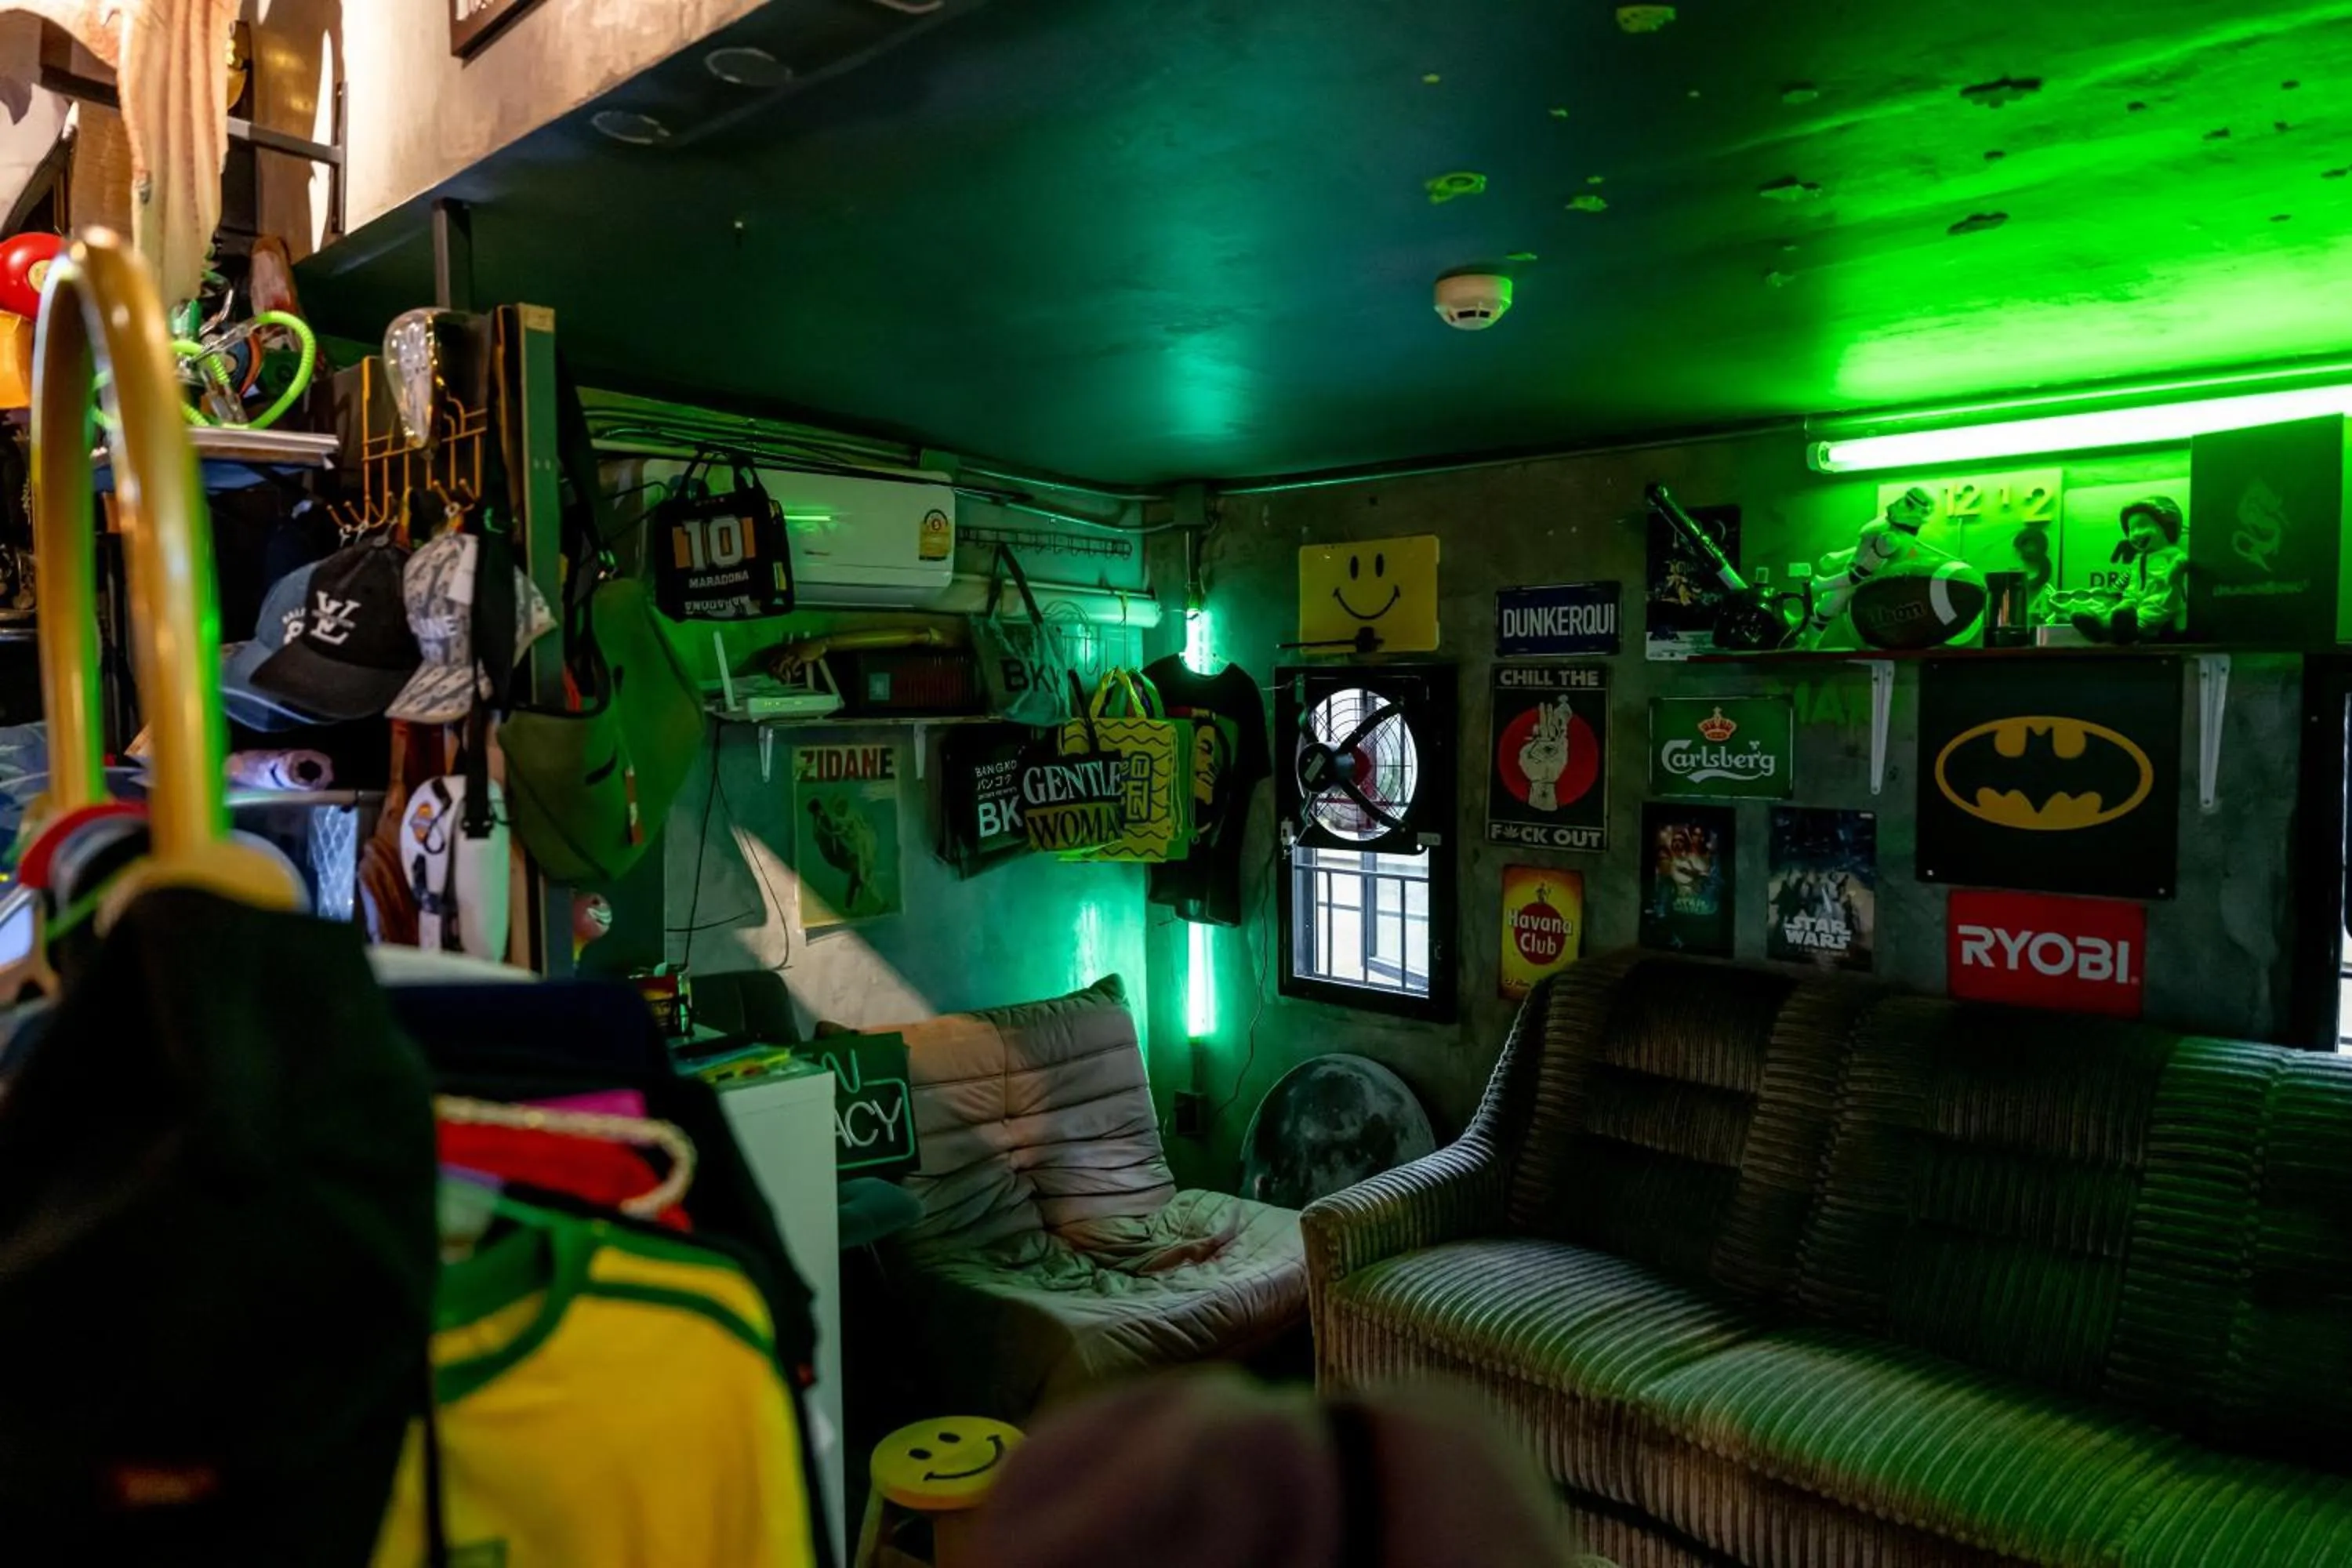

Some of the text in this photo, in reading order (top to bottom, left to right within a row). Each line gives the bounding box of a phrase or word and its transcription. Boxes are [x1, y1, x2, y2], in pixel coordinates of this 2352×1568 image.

[683, 515, 743, 572] 10
[688, 570, 750, 589] MARADONA
[1500, 669, 1599, 687] CHILL THE
[800, 748, 895, 782] ZIDANE
[1661, 739, 1775, 783] Carlsberg
[1023, 760, 1123, 804] GENTLE
[1491, 823, 1602, 848] FCK OUT
[1508, 908, 1573, 935] Havana
[1784, 914, 1849, 935] STAR
[1519, 933, 1557, 956] Club
[1785, 929, 1851, 950] WARS
[1958, 924, 2129, 984] RYOBI
[836, 1097, 902, 1148] ACY
